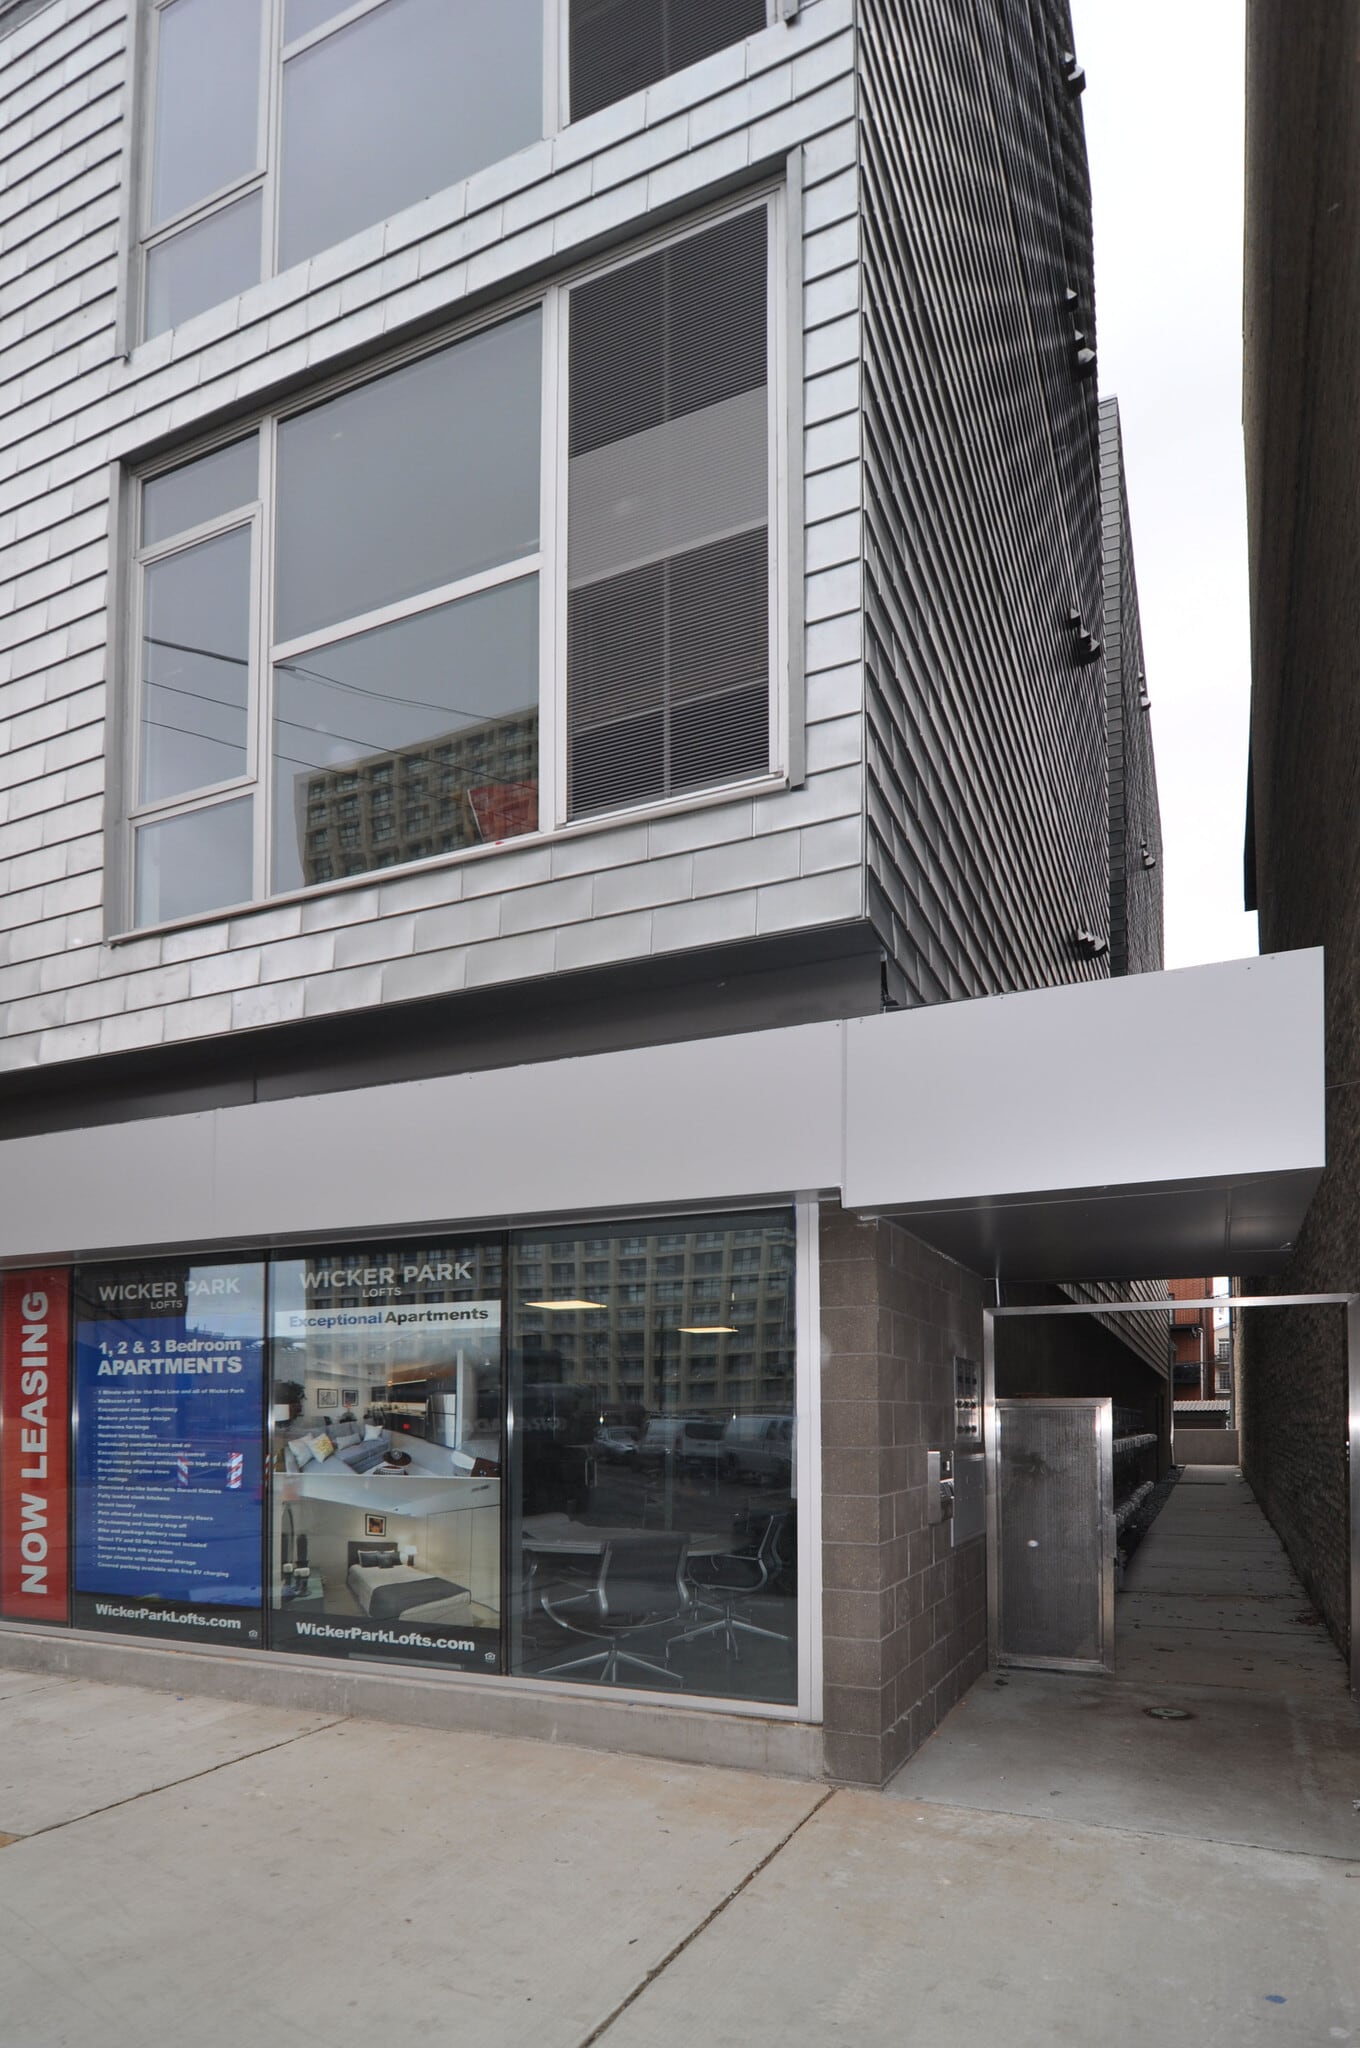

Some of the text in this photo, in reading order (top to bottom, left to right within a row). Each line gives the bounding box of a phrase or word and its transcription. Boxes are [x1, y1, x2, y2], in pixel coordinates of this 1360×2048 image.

[300, 1261, 472, 1289] WICKER PARK
[98, 1278, 240, 1301] WICKER PARK
[362, 1287, 402, 1298] LOFTS
[150, 1299, 183, 1310] LOFTS
[289, 1307, 489, 1329] Exceptional Apartments
[98, 1338, 241, 1357] 1, 2 & 3 Bedroom
[97, 1356, 242, 1376] APARTMENTS
[21, 1291, 48, 1594] NOW LEASING
[95, 1603, 241, 1629] WickerParkLofts.com
[295, 1621, 475, 1651] WickerParkLofts.com
